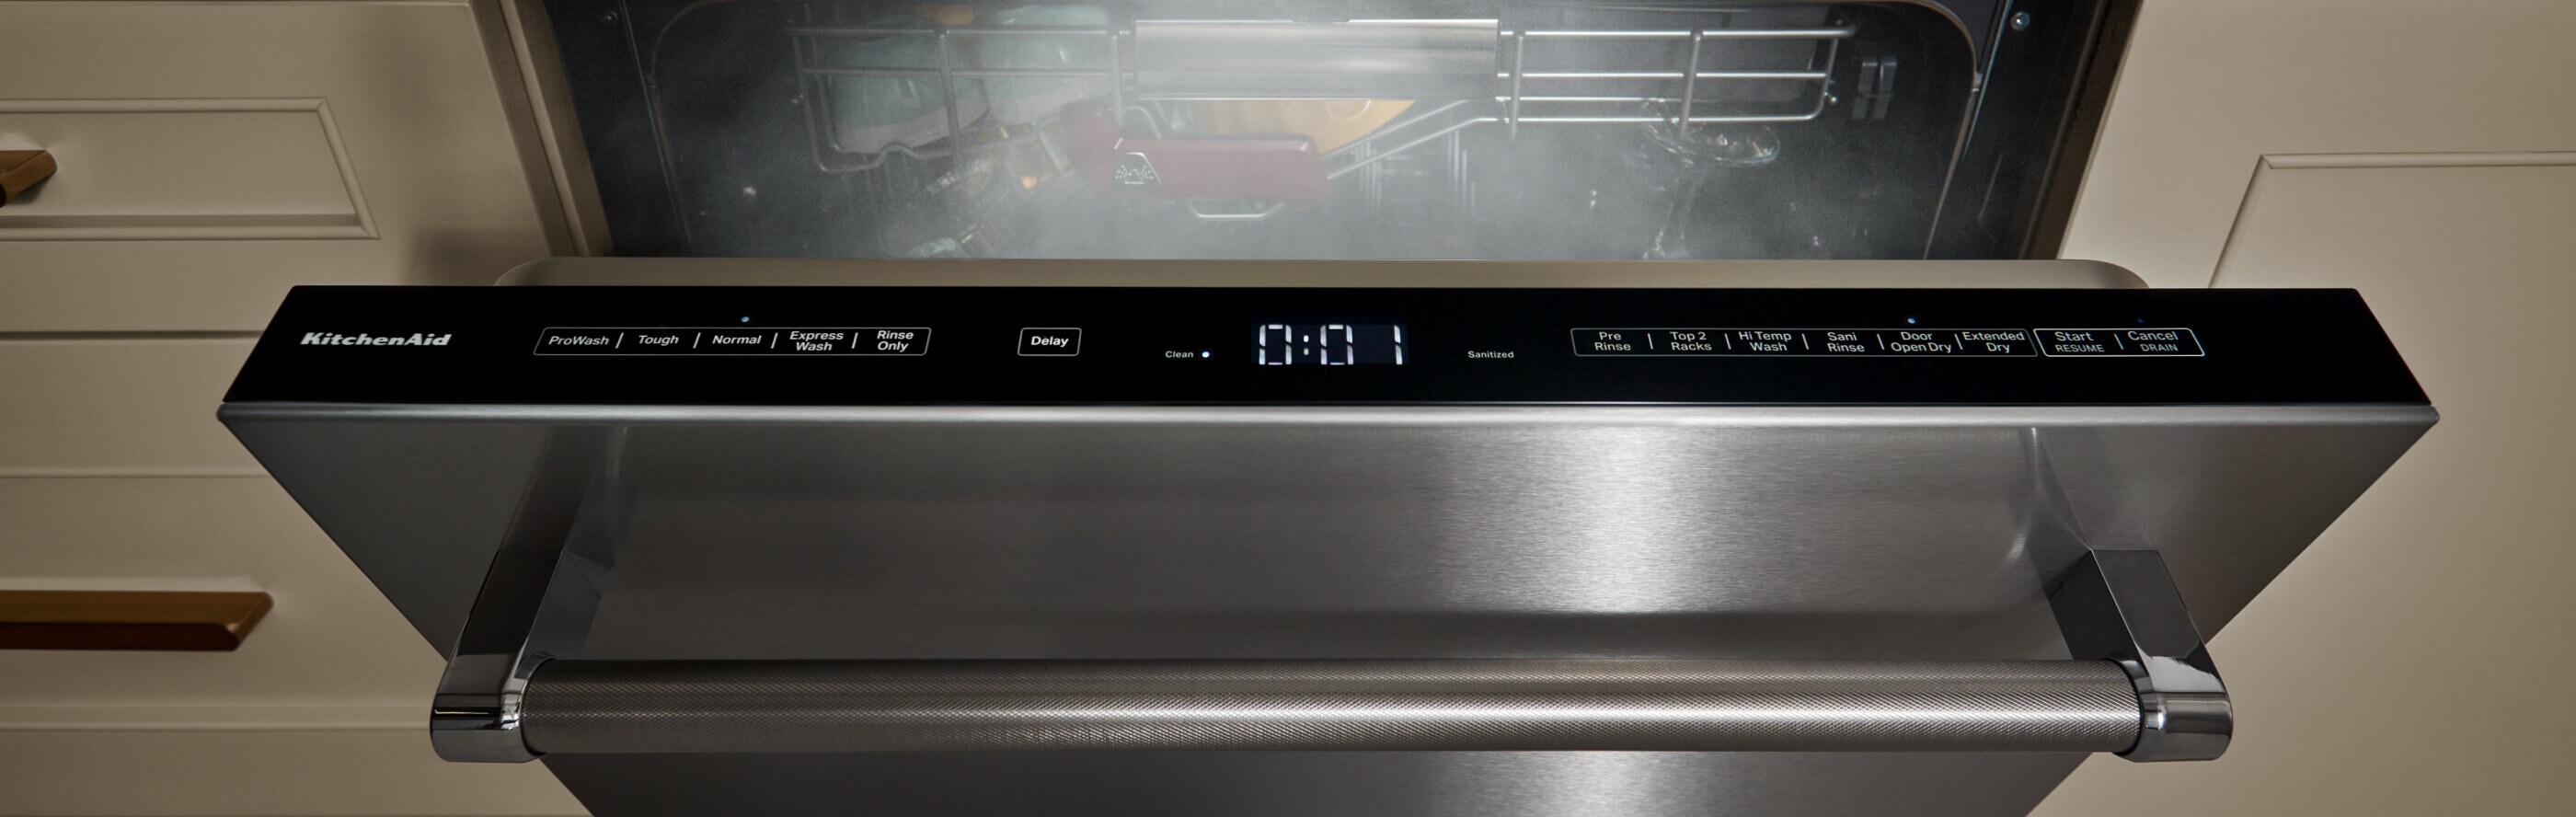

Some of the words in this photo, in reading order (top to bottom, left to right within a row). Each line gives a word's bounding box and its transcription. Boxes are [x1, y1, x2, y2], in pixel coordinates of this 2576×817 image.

[301, 332, 452, 345] KitchenAid
[712, 335, 762, 344] Normal
[789, 331, 844, 341] Express
[877, 330, 914, 339] Rinse
[1599, 332, 1621, 340] Pre
[1670, 332, 1695, 342] Top
[1739, 331, 1753, 339] Hi
[1754, 331, 1791, 343] Temp
[1827, 332, 1857, 340] Sani
[1901, 332, 1932, 340] Door
[1962, 331, 2027, 340] Extended
[2055, 331, 2094, 341] Start
[2128, 331, 2179, 340] Cancel
[548, 336, 609, 345] ProWash
[638, 335, 679, 346] Tough
[1031, 336, 1069, 347] Delay
[797, 342, 833, 351] Wash
[878, 341, 909, 352] Only
[1594, 342, 1631, 351] Rinse
[1671, 341, 1712, 351] Racks
[1749, 341, 1788, 351] Wash
[1827, 343, 1865, 351] Rinse
[1891, 342, 1926, 353] Open
[1928, 342, 1951, 353] Dry
[1986, 342, 2009, 353] Dry
